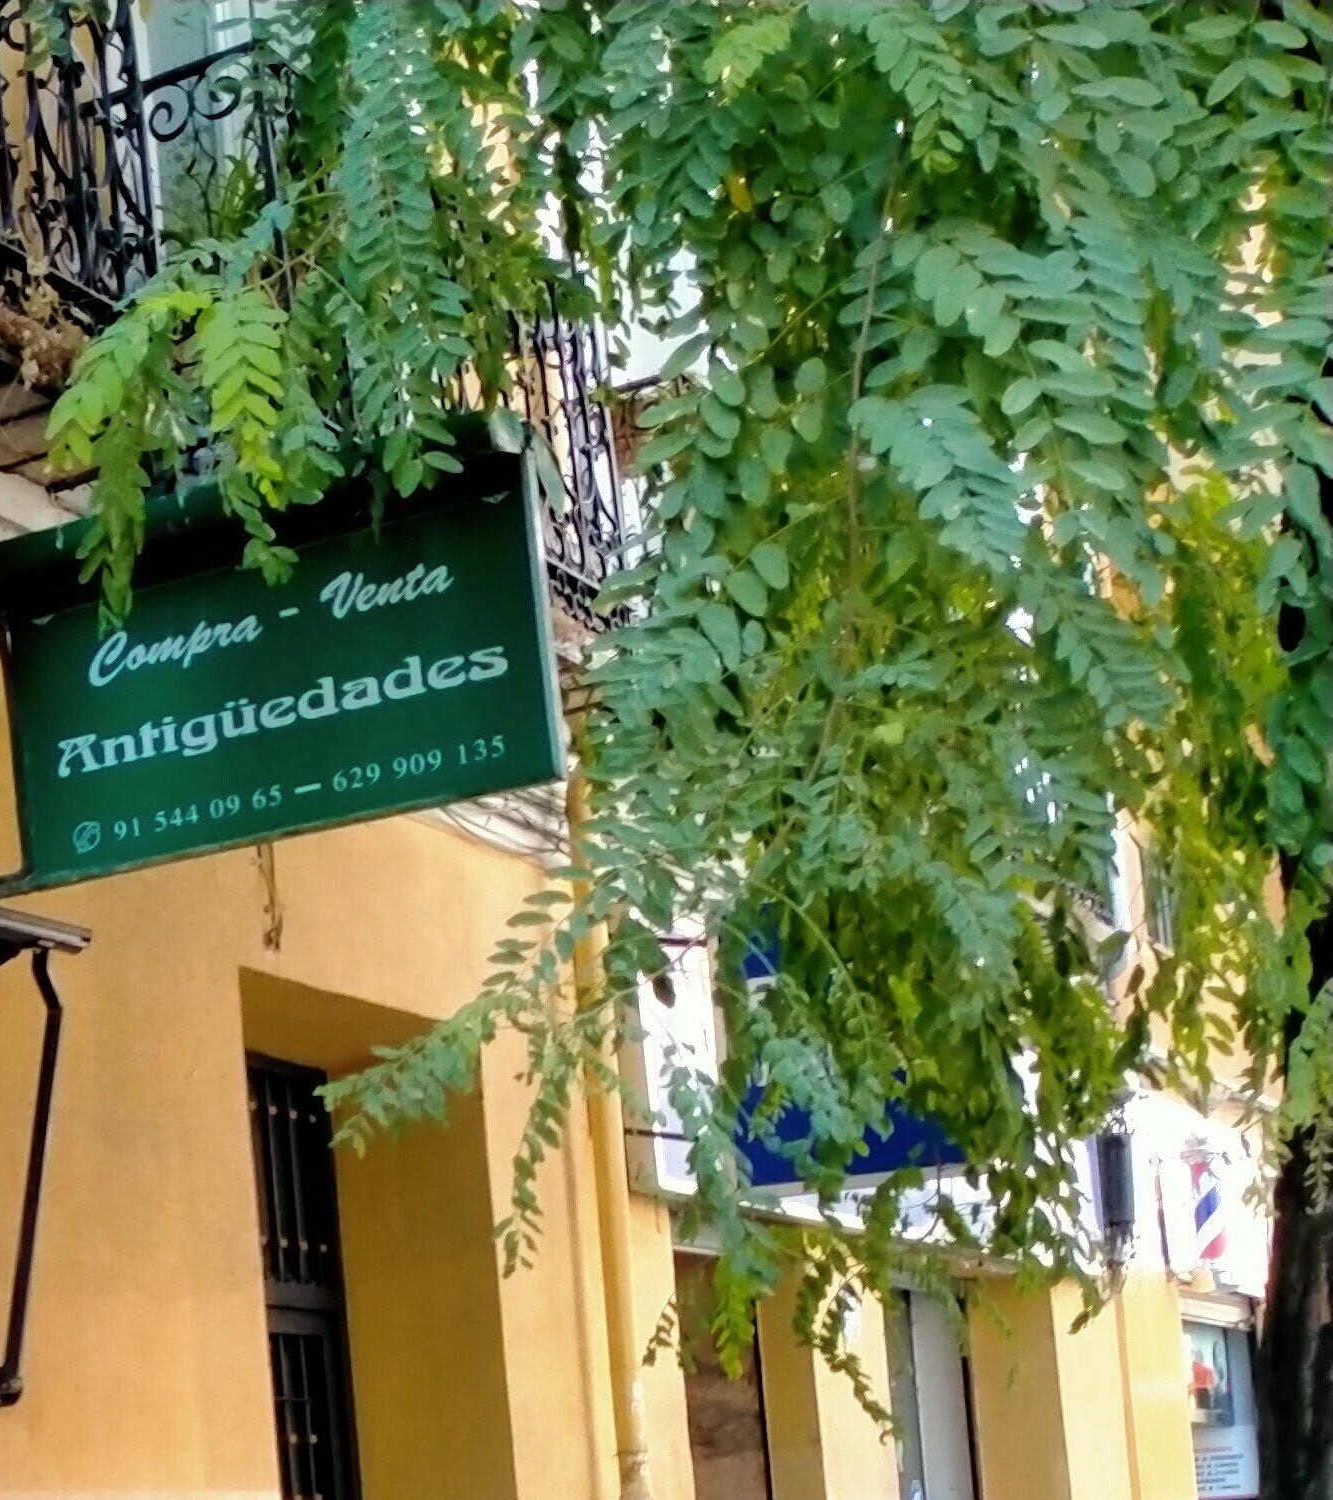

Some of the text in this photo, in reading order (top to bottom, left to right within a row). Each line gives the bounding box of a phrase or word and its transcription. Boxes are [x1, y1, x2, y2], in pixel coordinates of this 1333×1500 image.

[87, 614, 264, 687] Compra
[319, 562, 455, 620] Venta
[56, 645, 509, 778] Antigüedades
[112, 815, 141, 842] 91
[154, 805, 201, 834] 544
[209, 794, 241, 820] 09
[251, 784, 283, 809] 65
[332, 762, 382, 793] 629
[391, 749, 443, 780] 909
[457, 734, 507, 766] 135
